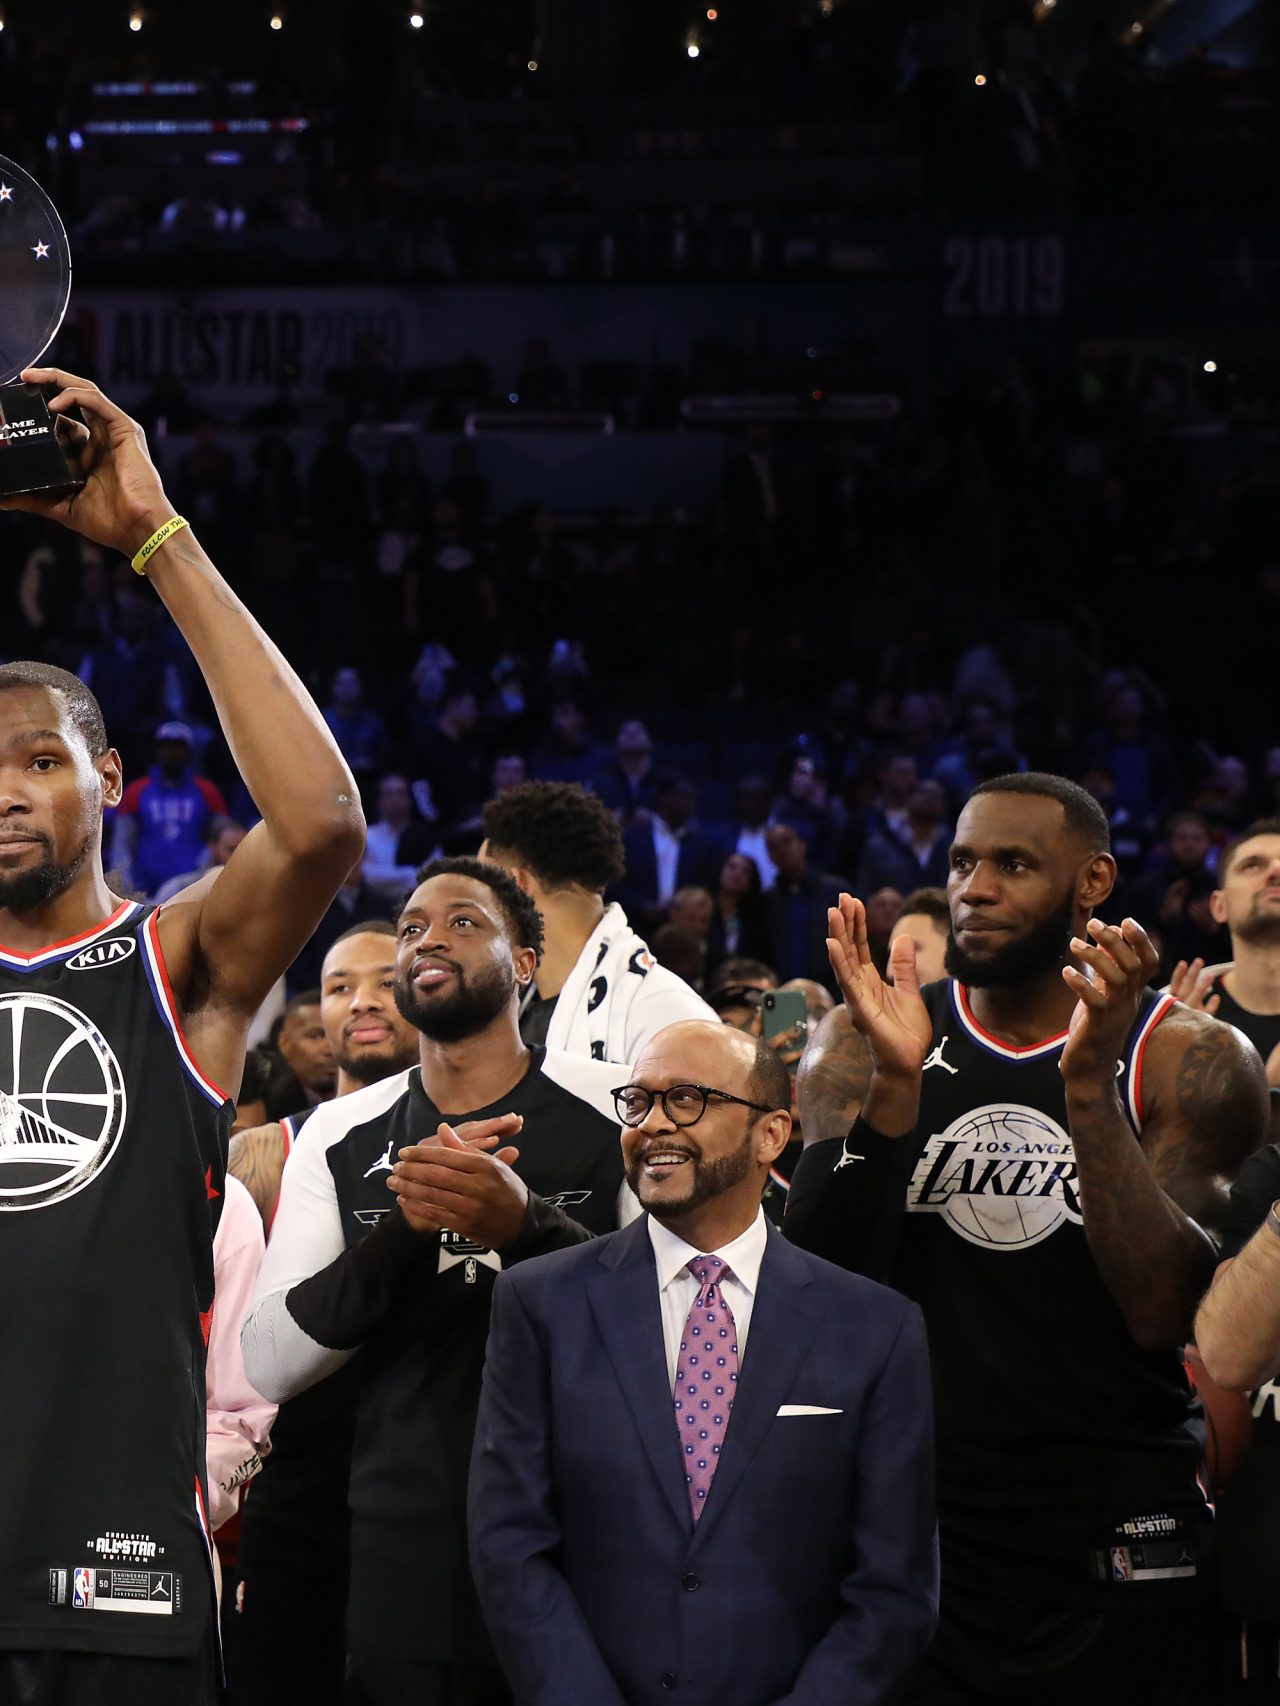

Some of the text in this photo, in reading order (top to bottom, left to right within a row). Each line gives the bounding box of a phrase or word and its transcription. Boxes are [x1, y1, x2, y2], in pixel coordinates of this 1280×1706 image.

[942, 235, 1066, 318] 2019
[141, 526, 170, 558] FOLLOW
[78, 942, 126, 967] KIA
[972, 1142, 1012, 1153] LOS
[911, 1140, 1082, 1215] LAKER
[105, 1531, 150, 1541] CHARLOTTE
[102, 1554, 148, 1563] EDITION
[99, 1579, 109, 1588] 50
